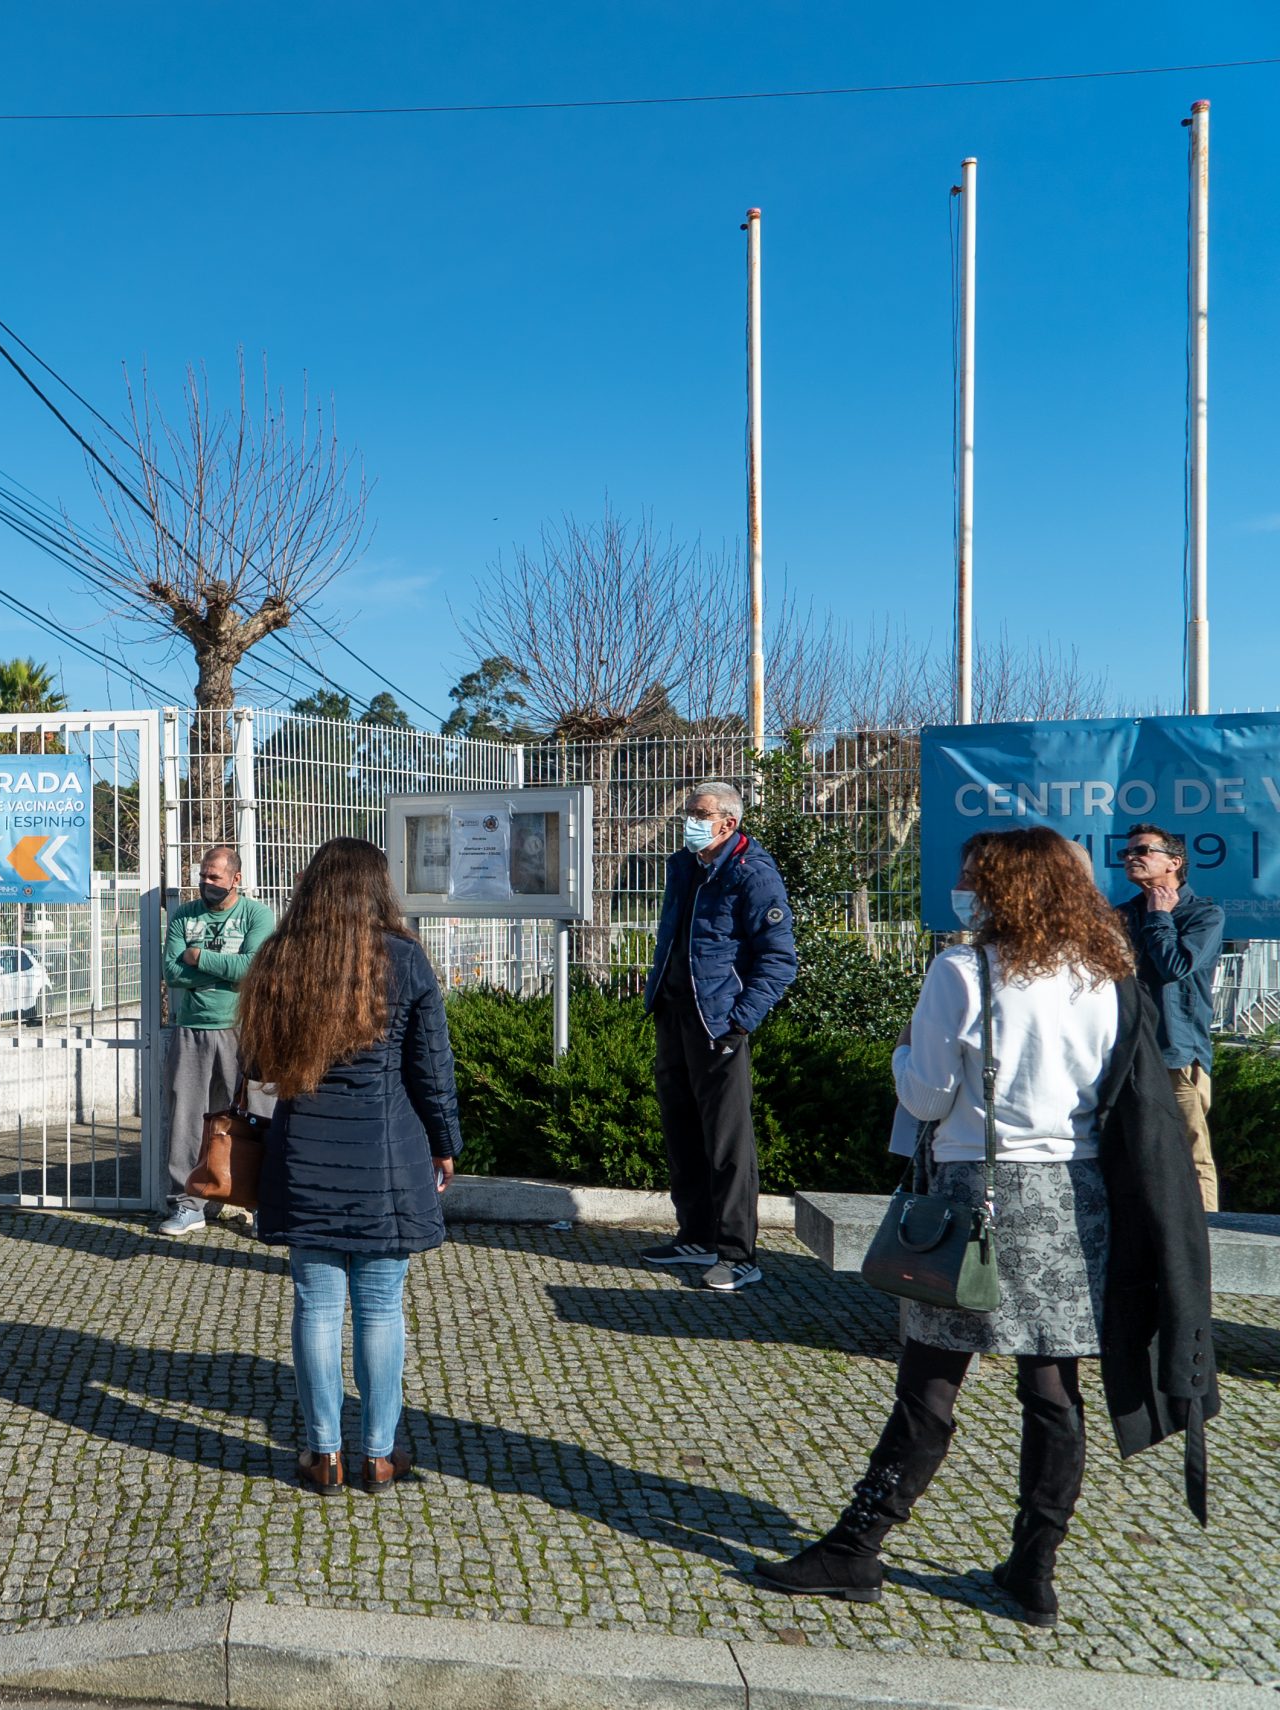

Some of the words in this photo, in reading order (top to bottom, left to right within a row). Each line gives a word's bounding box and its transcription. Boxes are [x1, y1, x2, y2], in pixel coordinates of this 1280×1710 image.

[955, 780, 1157, 817] CENTRO
[1174, 778, 1246, 814] DE
[7, 798, 84, 814] VACINAÇÃO
[14, 816, 85, 828] ESPINHO
